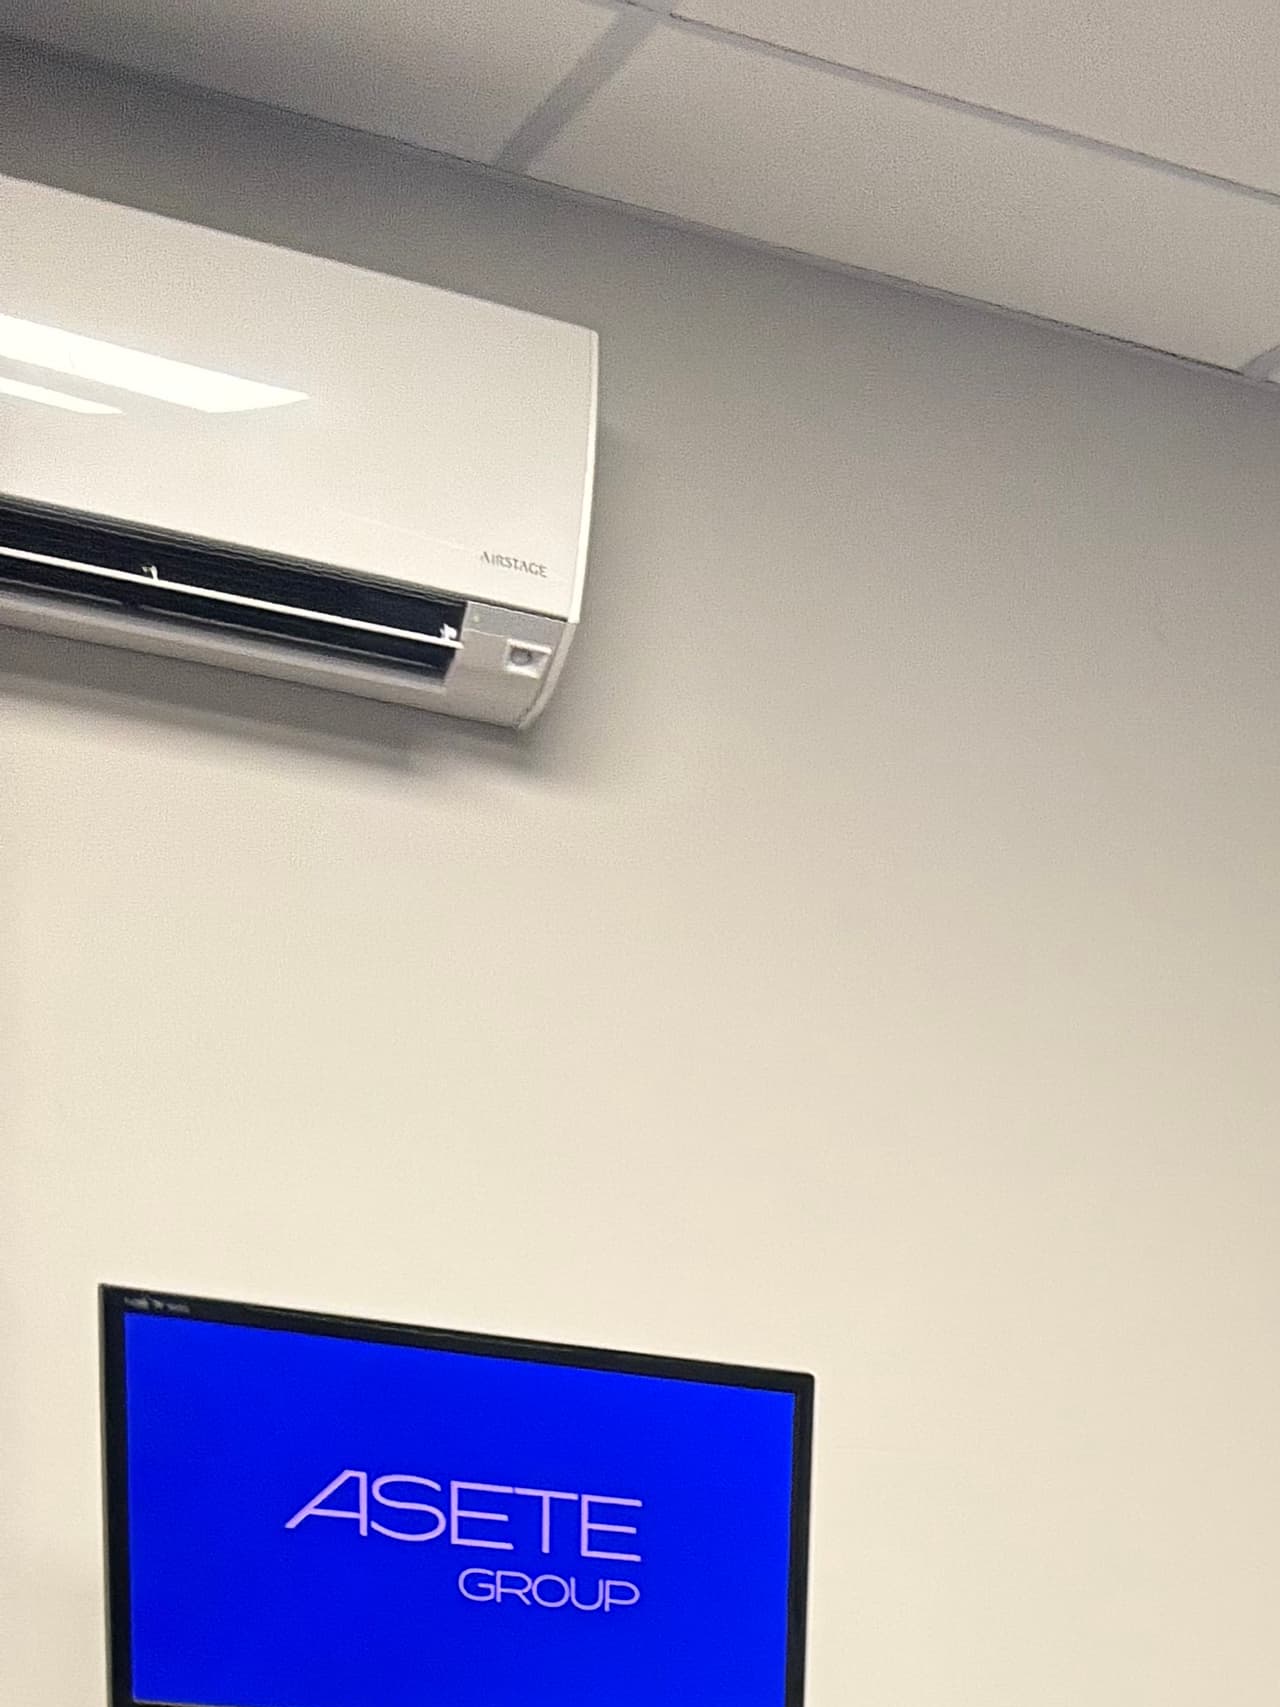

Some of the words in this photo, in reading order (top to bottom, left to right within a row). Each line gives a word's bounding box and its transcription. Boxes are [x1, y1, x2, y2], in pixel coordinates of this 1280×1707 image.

[480, 551, 548, 578] AIRSTAGE
[285, 1469, 643, 1563] ASETE
[458, 1567, 641, 1613] GROUP
